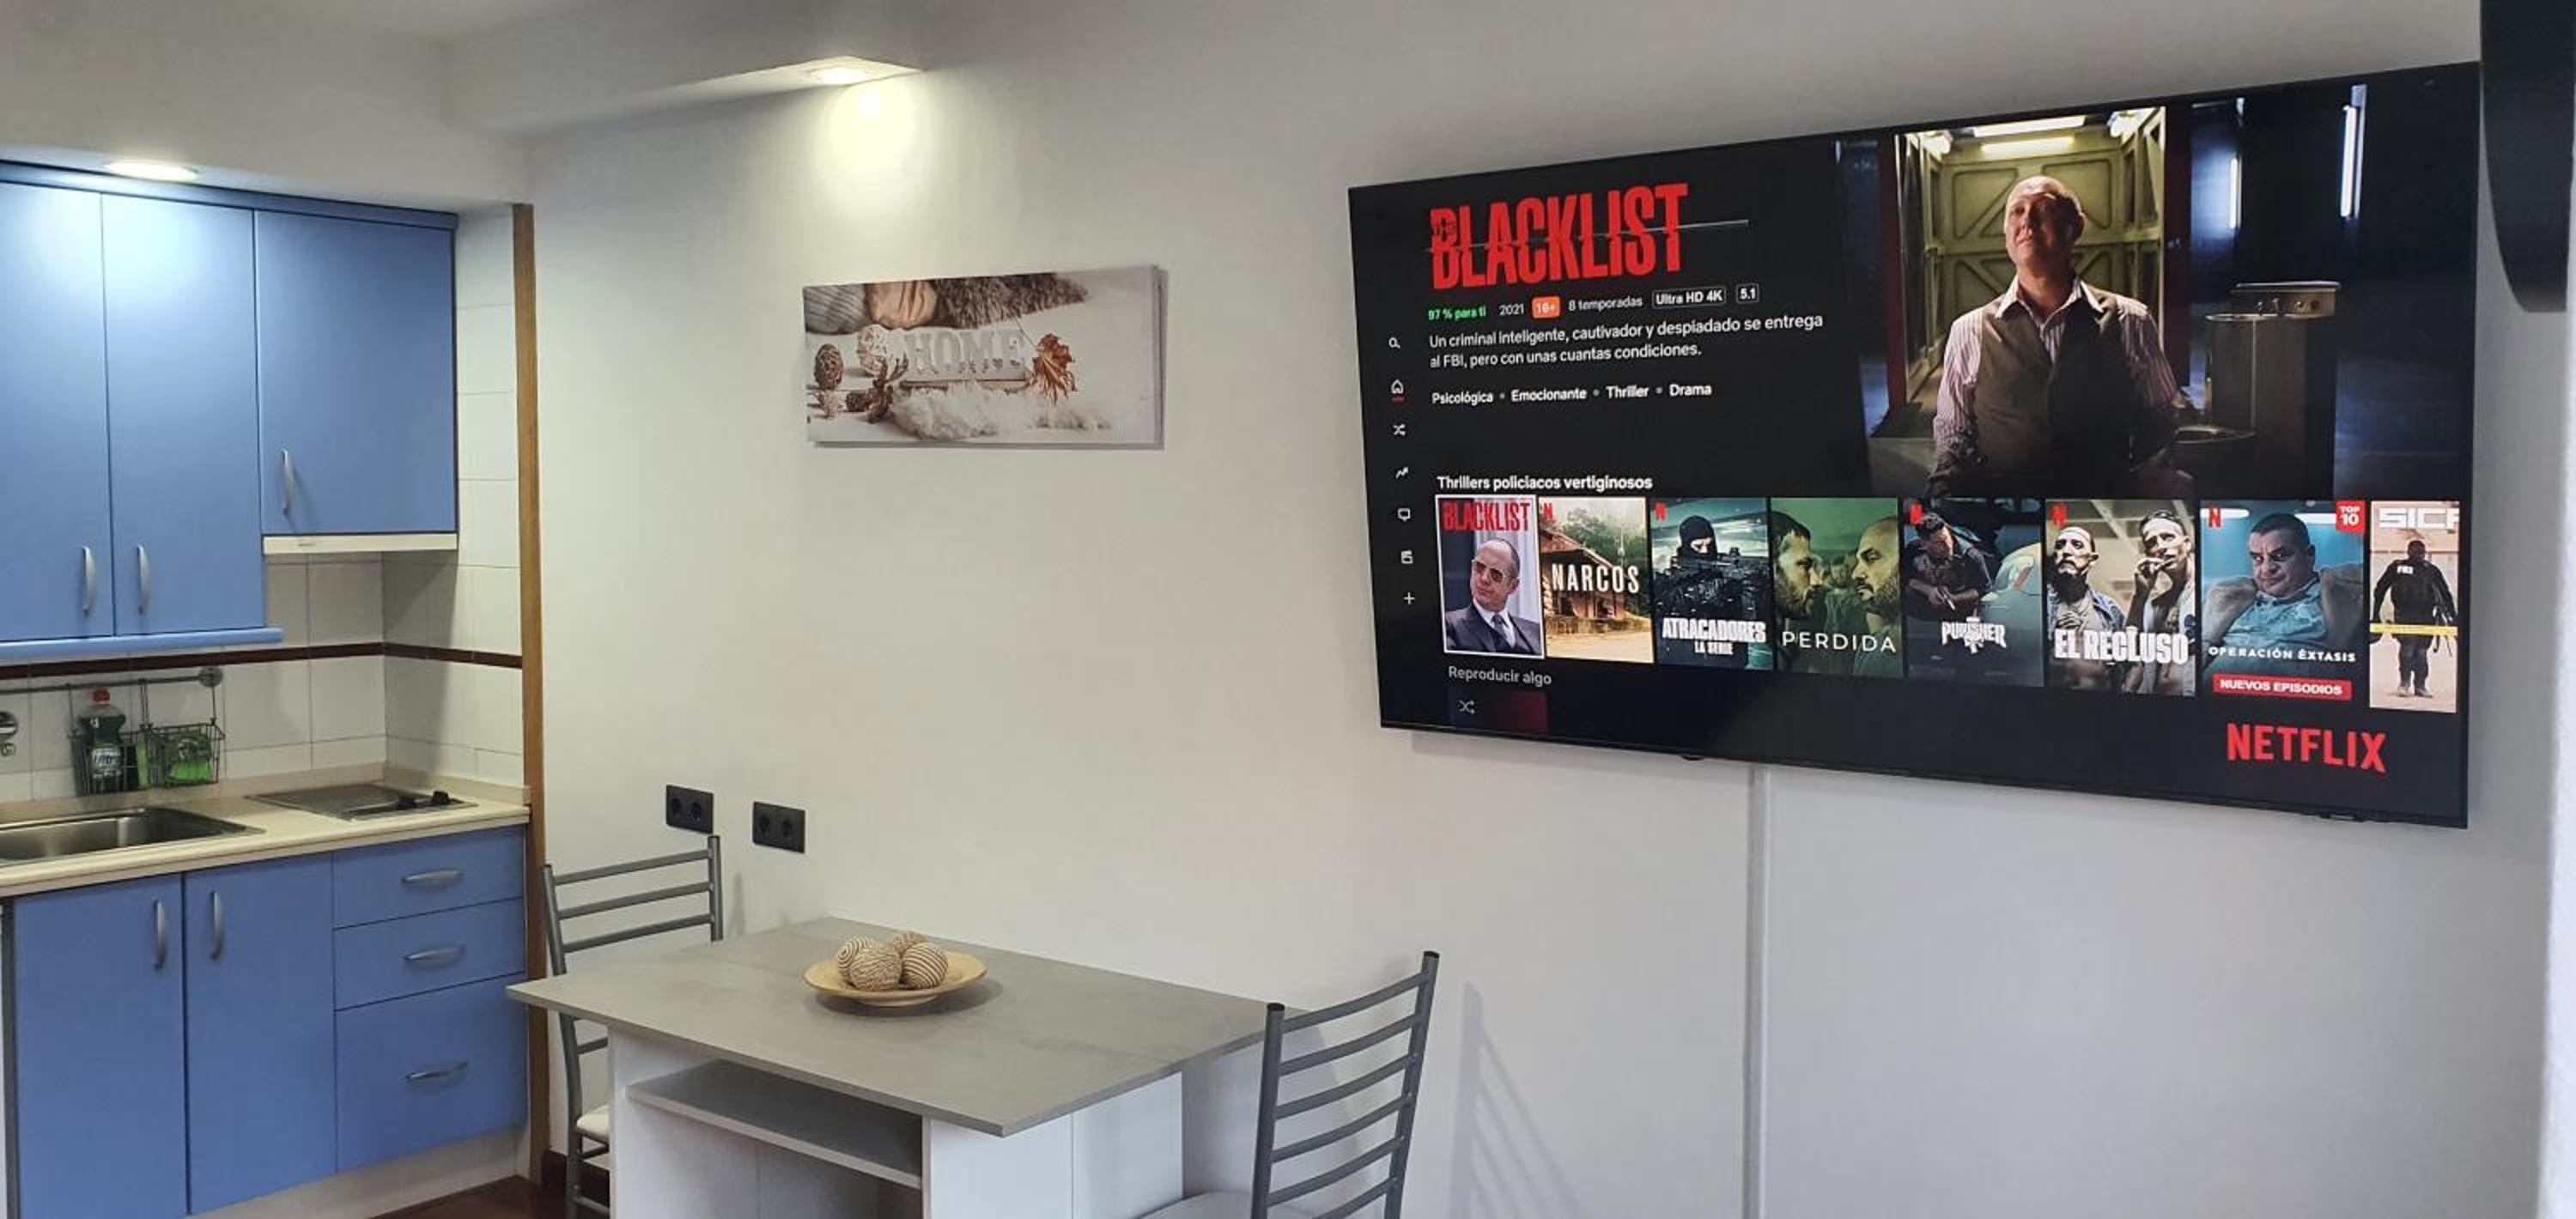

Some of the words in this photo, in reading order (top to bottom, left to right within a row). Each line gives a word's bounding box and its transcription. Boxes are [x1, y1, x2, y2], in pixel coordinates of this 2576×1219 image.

[1430, 183, 1688, 289] BLACKLIST
[1568, 300, 1576, 312] 8
[1578, 296, 1643, 312] temporadas
[1656, 294, 1683, 306] Ultra
[1686, 291, 1704, 303] HD
[1706, 290, 1722, 301] 4K
[1740, 288, 1756, 300] 5.1
[1429, 309, 1440, 320] 97
[1455, 307, 1477, 320] para
[1479, 306, 1486, 317] ti
[1498, 303, 1524, 316] 2021
[1429, 335, 1446, 348] Un
[1449, 331, 1496, 347] criminal
[1498, 327, 1570, 346] inteligente,
[1572, 325, 1643, 341] cautivador
[1645, 326, 1653, 338] y
[1657, 318, 1741, 337] despiadado
[1744, 318, 1760, 329] se
[1765, 315, 1823, 331] entrega
[903, 330, 1024, 366] HOME
[1431, 355, 1440, 368] al
[1443, 354, 1467, 368] FBI,
[1470, 355, 1498, 369] pero
[1500, 353, 1523, 365] con
[1526, 350, 1557, 363] unas
[1559, 345, 1612, 361] cuantas
[1614, 343, 1703, 359] condiciones.
[1431, 391, 1494, 406] Psicológica
[1510, 388, 1588, 403] Emocionante
[1606, 385, 1649, 399] Thriller
[1669, 383, 1712, 397] Drama
[1437, 476, 1491, 489] Thrillers
[1564, 475, 1654, 493] vertiginosos
[1442, 501, 1531, 532] BLACKLIST
[2339, 505, 2361, 513] TOP
[2342, 513, 2360, 526] 10
[1551, 562, 1640, 593] NARCOS
[1662, 617, 1766, 643] ATRACADORES
[1941, 620, 2007, 649] PUNISHER
[1694, 640, 1705, 653] LA
[1707, 641, 1734, 655] SERIE
[1782, 631, 1897, 652] PERDIDA
[2055, 628, 2080, 658] EL
[2083, 626, 2189, 664] RECLUSO
[2208, 646, 2293, 659] OPERACIÓN
[2297, 648, 2356, 663] ÉXTASIS
[1449, 665, 1520, 682] Reproducir
[1522, 670, 1552, 687] algo
[2220, 679, 2270, 691] NUEVOS
[2274, 682, 2342, 695] EPISODIOS
[2227, 722, 2386, 773] NETFLIX
